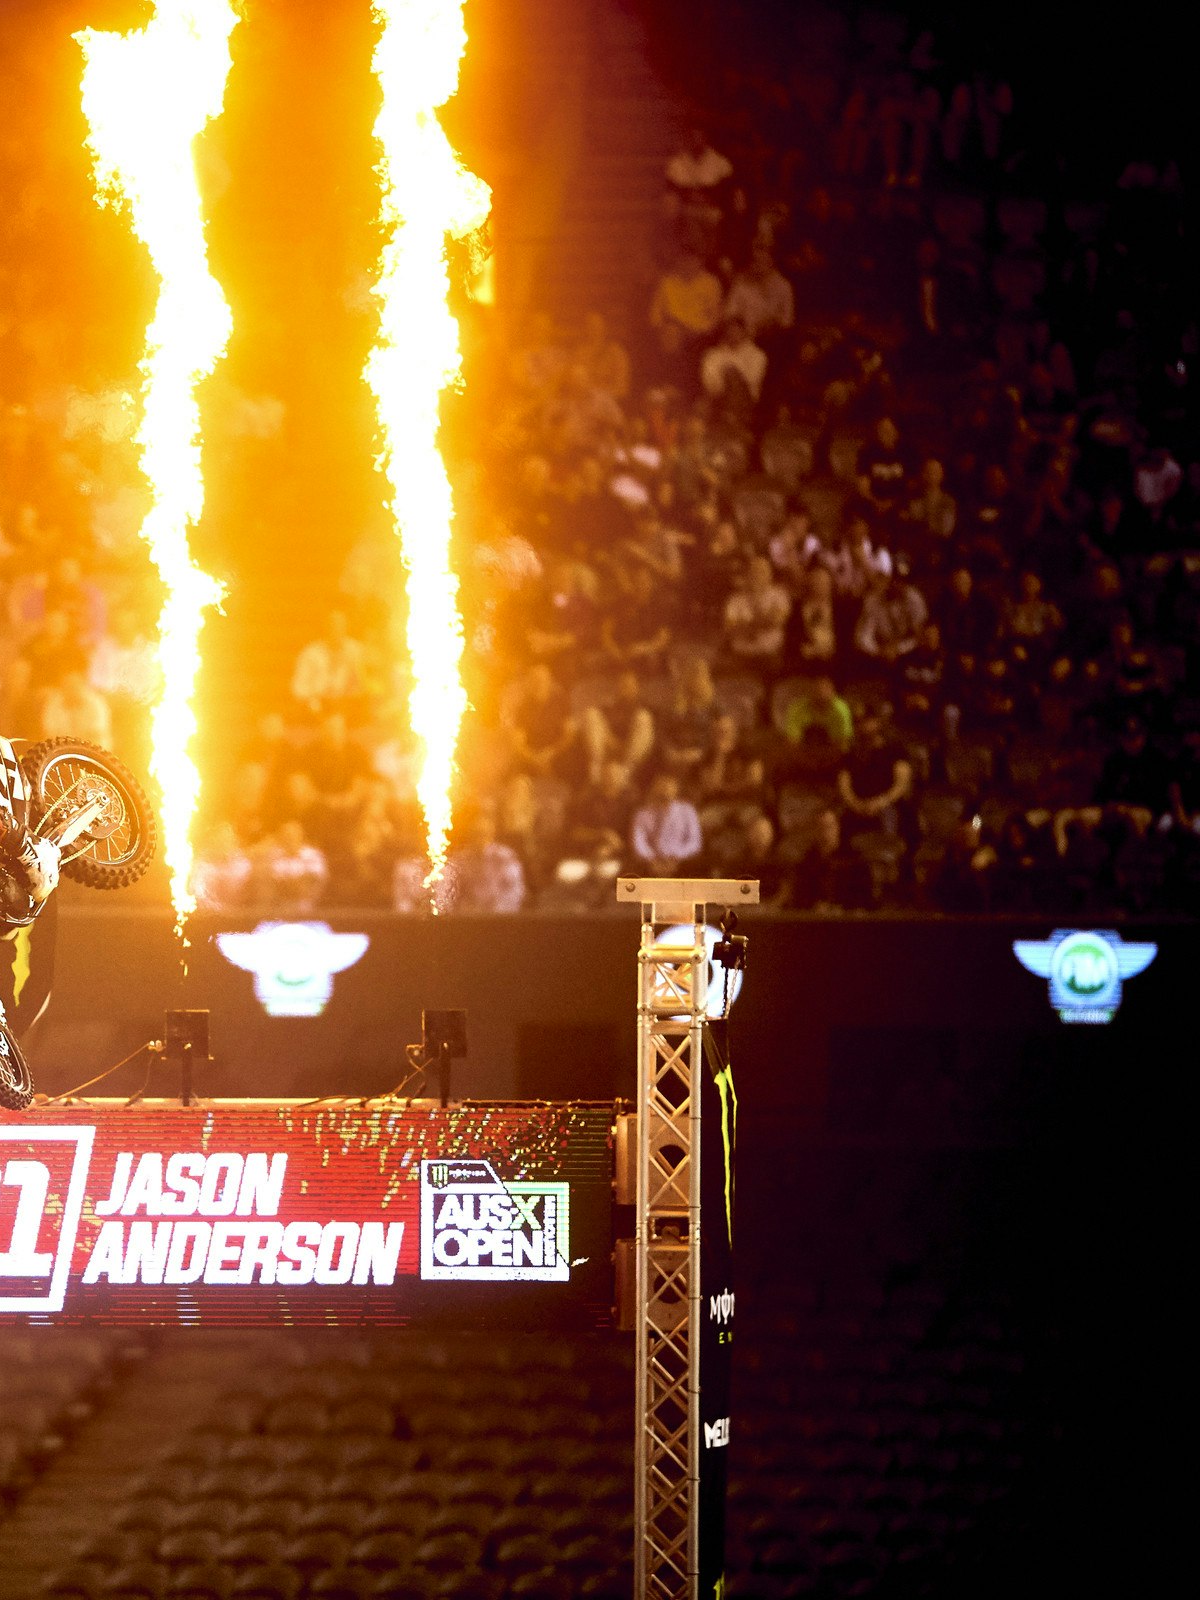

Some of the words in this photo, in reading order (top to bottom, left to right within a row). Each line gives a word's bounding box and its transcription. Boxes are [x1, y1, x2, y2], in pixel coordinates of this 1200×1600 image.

[94, 1152, 289, 1216] JASON
[81, 1221, 405, 1285] ANDERSON
[432, 1229, 545, 1267] OPEN
